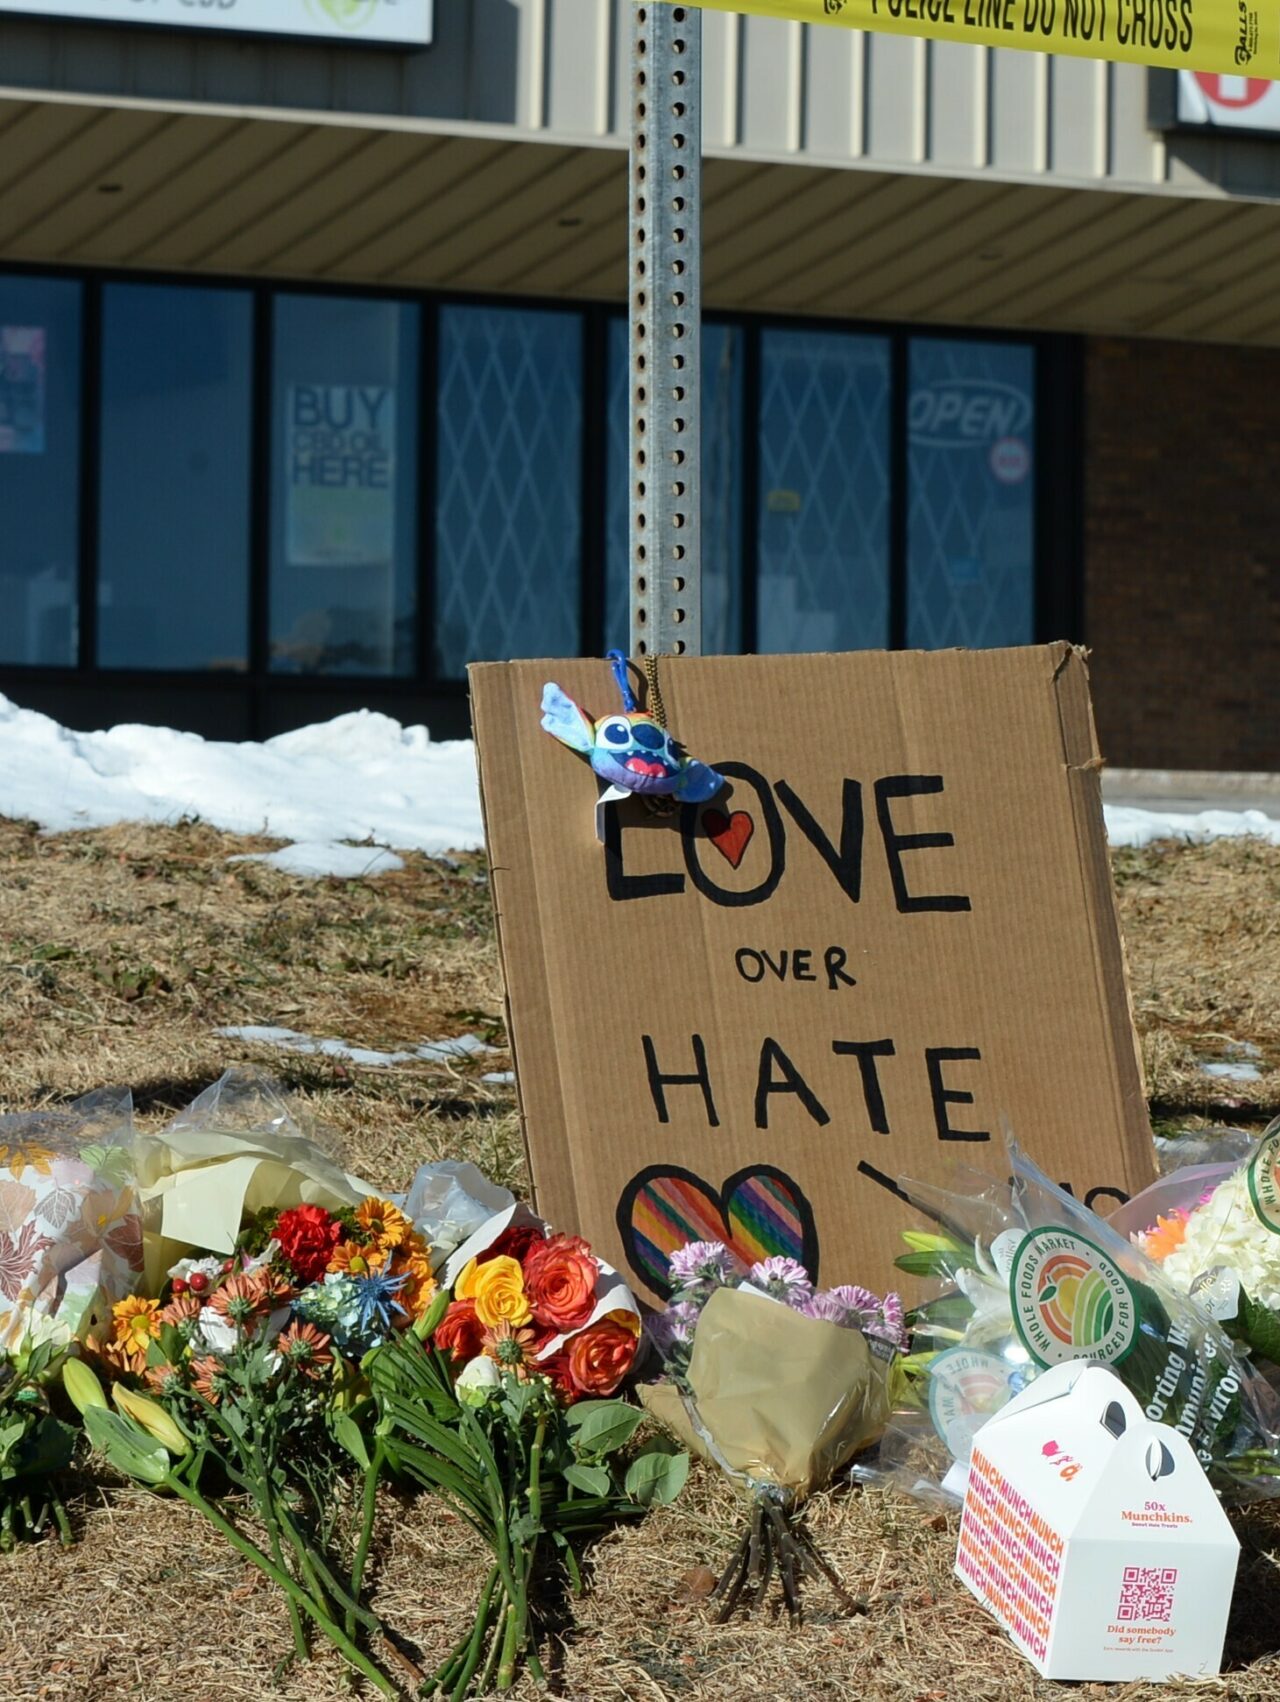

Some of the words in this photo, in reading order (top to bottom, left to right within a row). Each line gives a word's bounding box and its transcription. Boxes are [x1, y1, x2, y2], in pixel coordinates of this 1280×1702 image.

[1117, 0, 1193, 52] CROSS
[294, 385, 387, 429] BUY
[908, 389, 1018, 439] OPEN
[293, 452, 389, 488] HERE
[603, 761, 972, 914] LOVE
[735, 946, 857, 990] OVER
[642, 1033, 991, 1142] HATE
[1260, 1158, 1277, 1206] WHOLE
[1034, 1237, 1076, 1256] MARKET
[1021, 1254, 1039, 1299] FOODS
[1099, 1262, 1125, 1295] GOOD
[1023, 1305, 1051, 1352] WHOLE
[1118, 1301, 1129, 1329] FOR
[1121, 1510, 1193, 1523] Munchkins.
[1144, 1501, 1166, 1512] 50x
[1107, 1625, 1125, 1634] Did
[1126, 1626, 1176, 1637] somebody
[1118, 1637, 1134, 1645] say
[1137, 1636, 1162, 1645] free?
